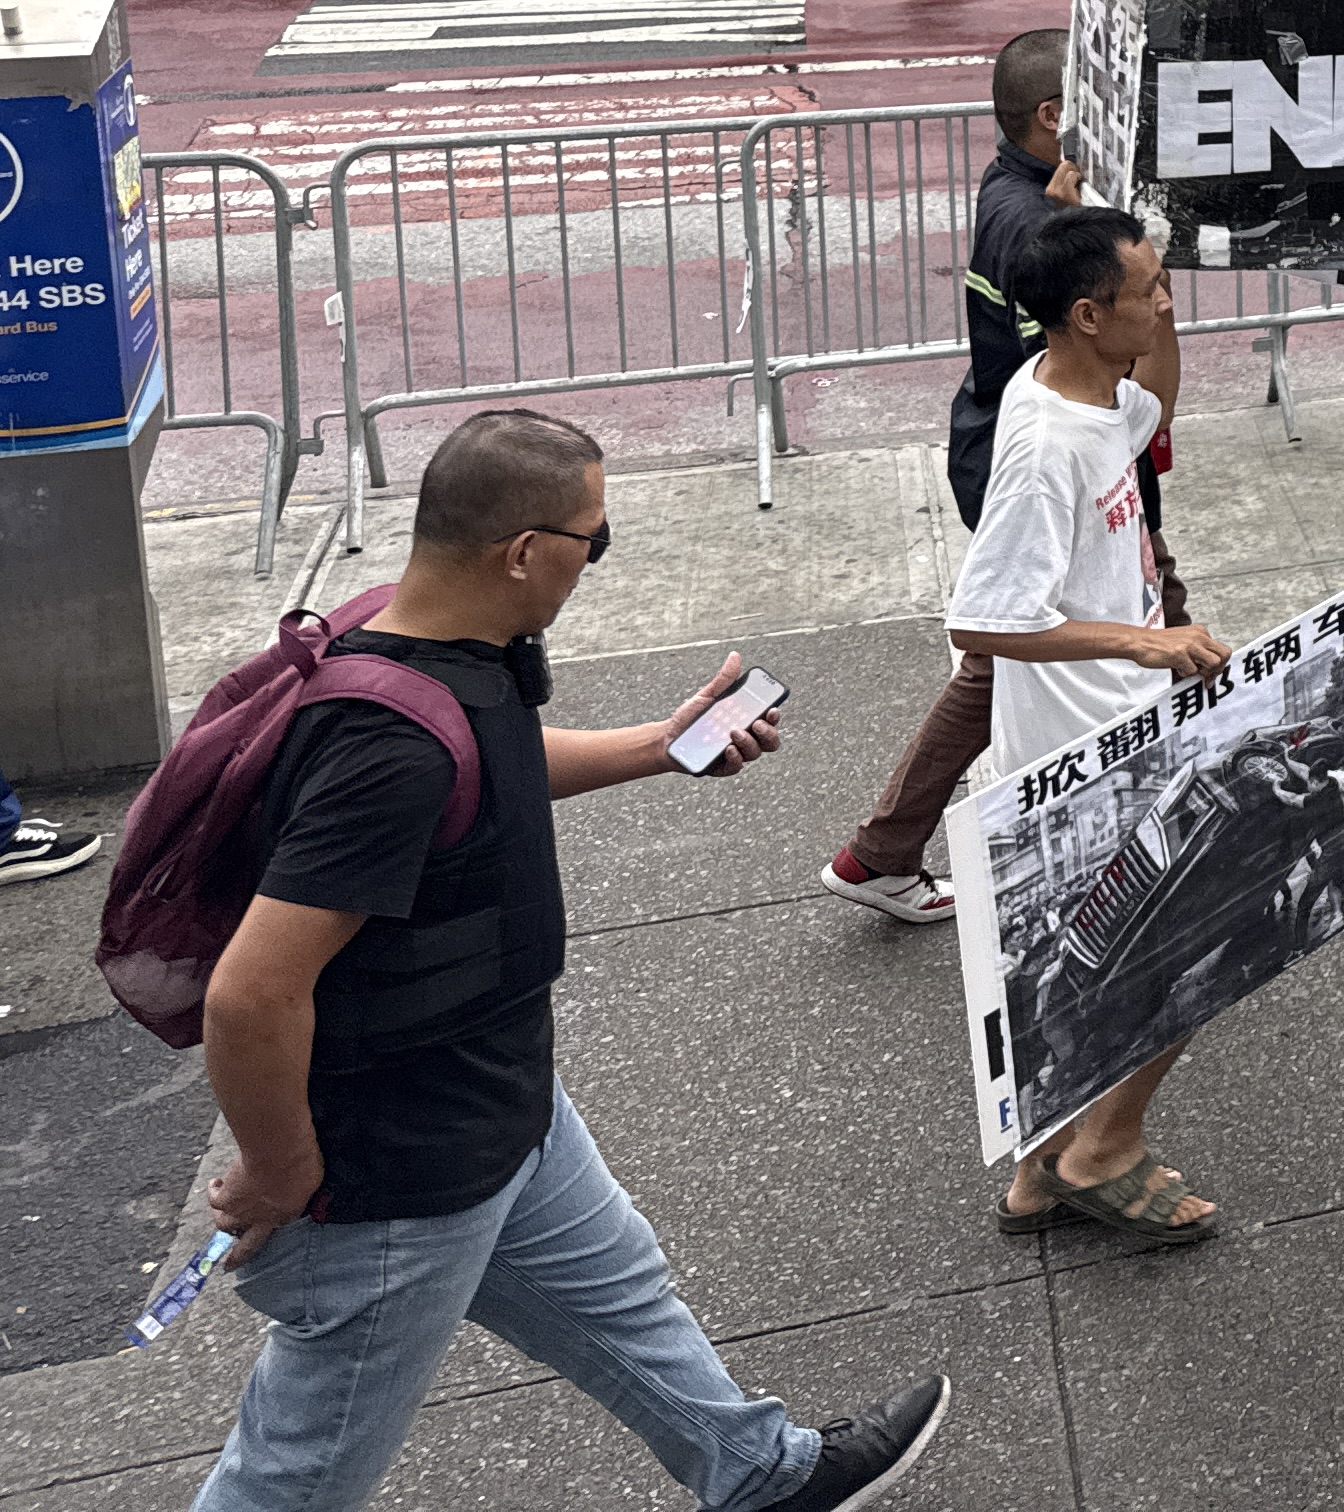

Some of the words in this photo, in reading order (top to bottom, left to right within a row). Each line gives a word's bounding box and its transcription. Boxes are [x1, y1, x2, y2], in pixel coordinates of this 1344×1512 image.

[120, 206, 146, 249] Ticket
[10, 254, 85, 278] Here
[39, 283, 107, 310] SBS
[26, 320, 58, 334] Bus
[1095, 474, 1128, 512] Release
